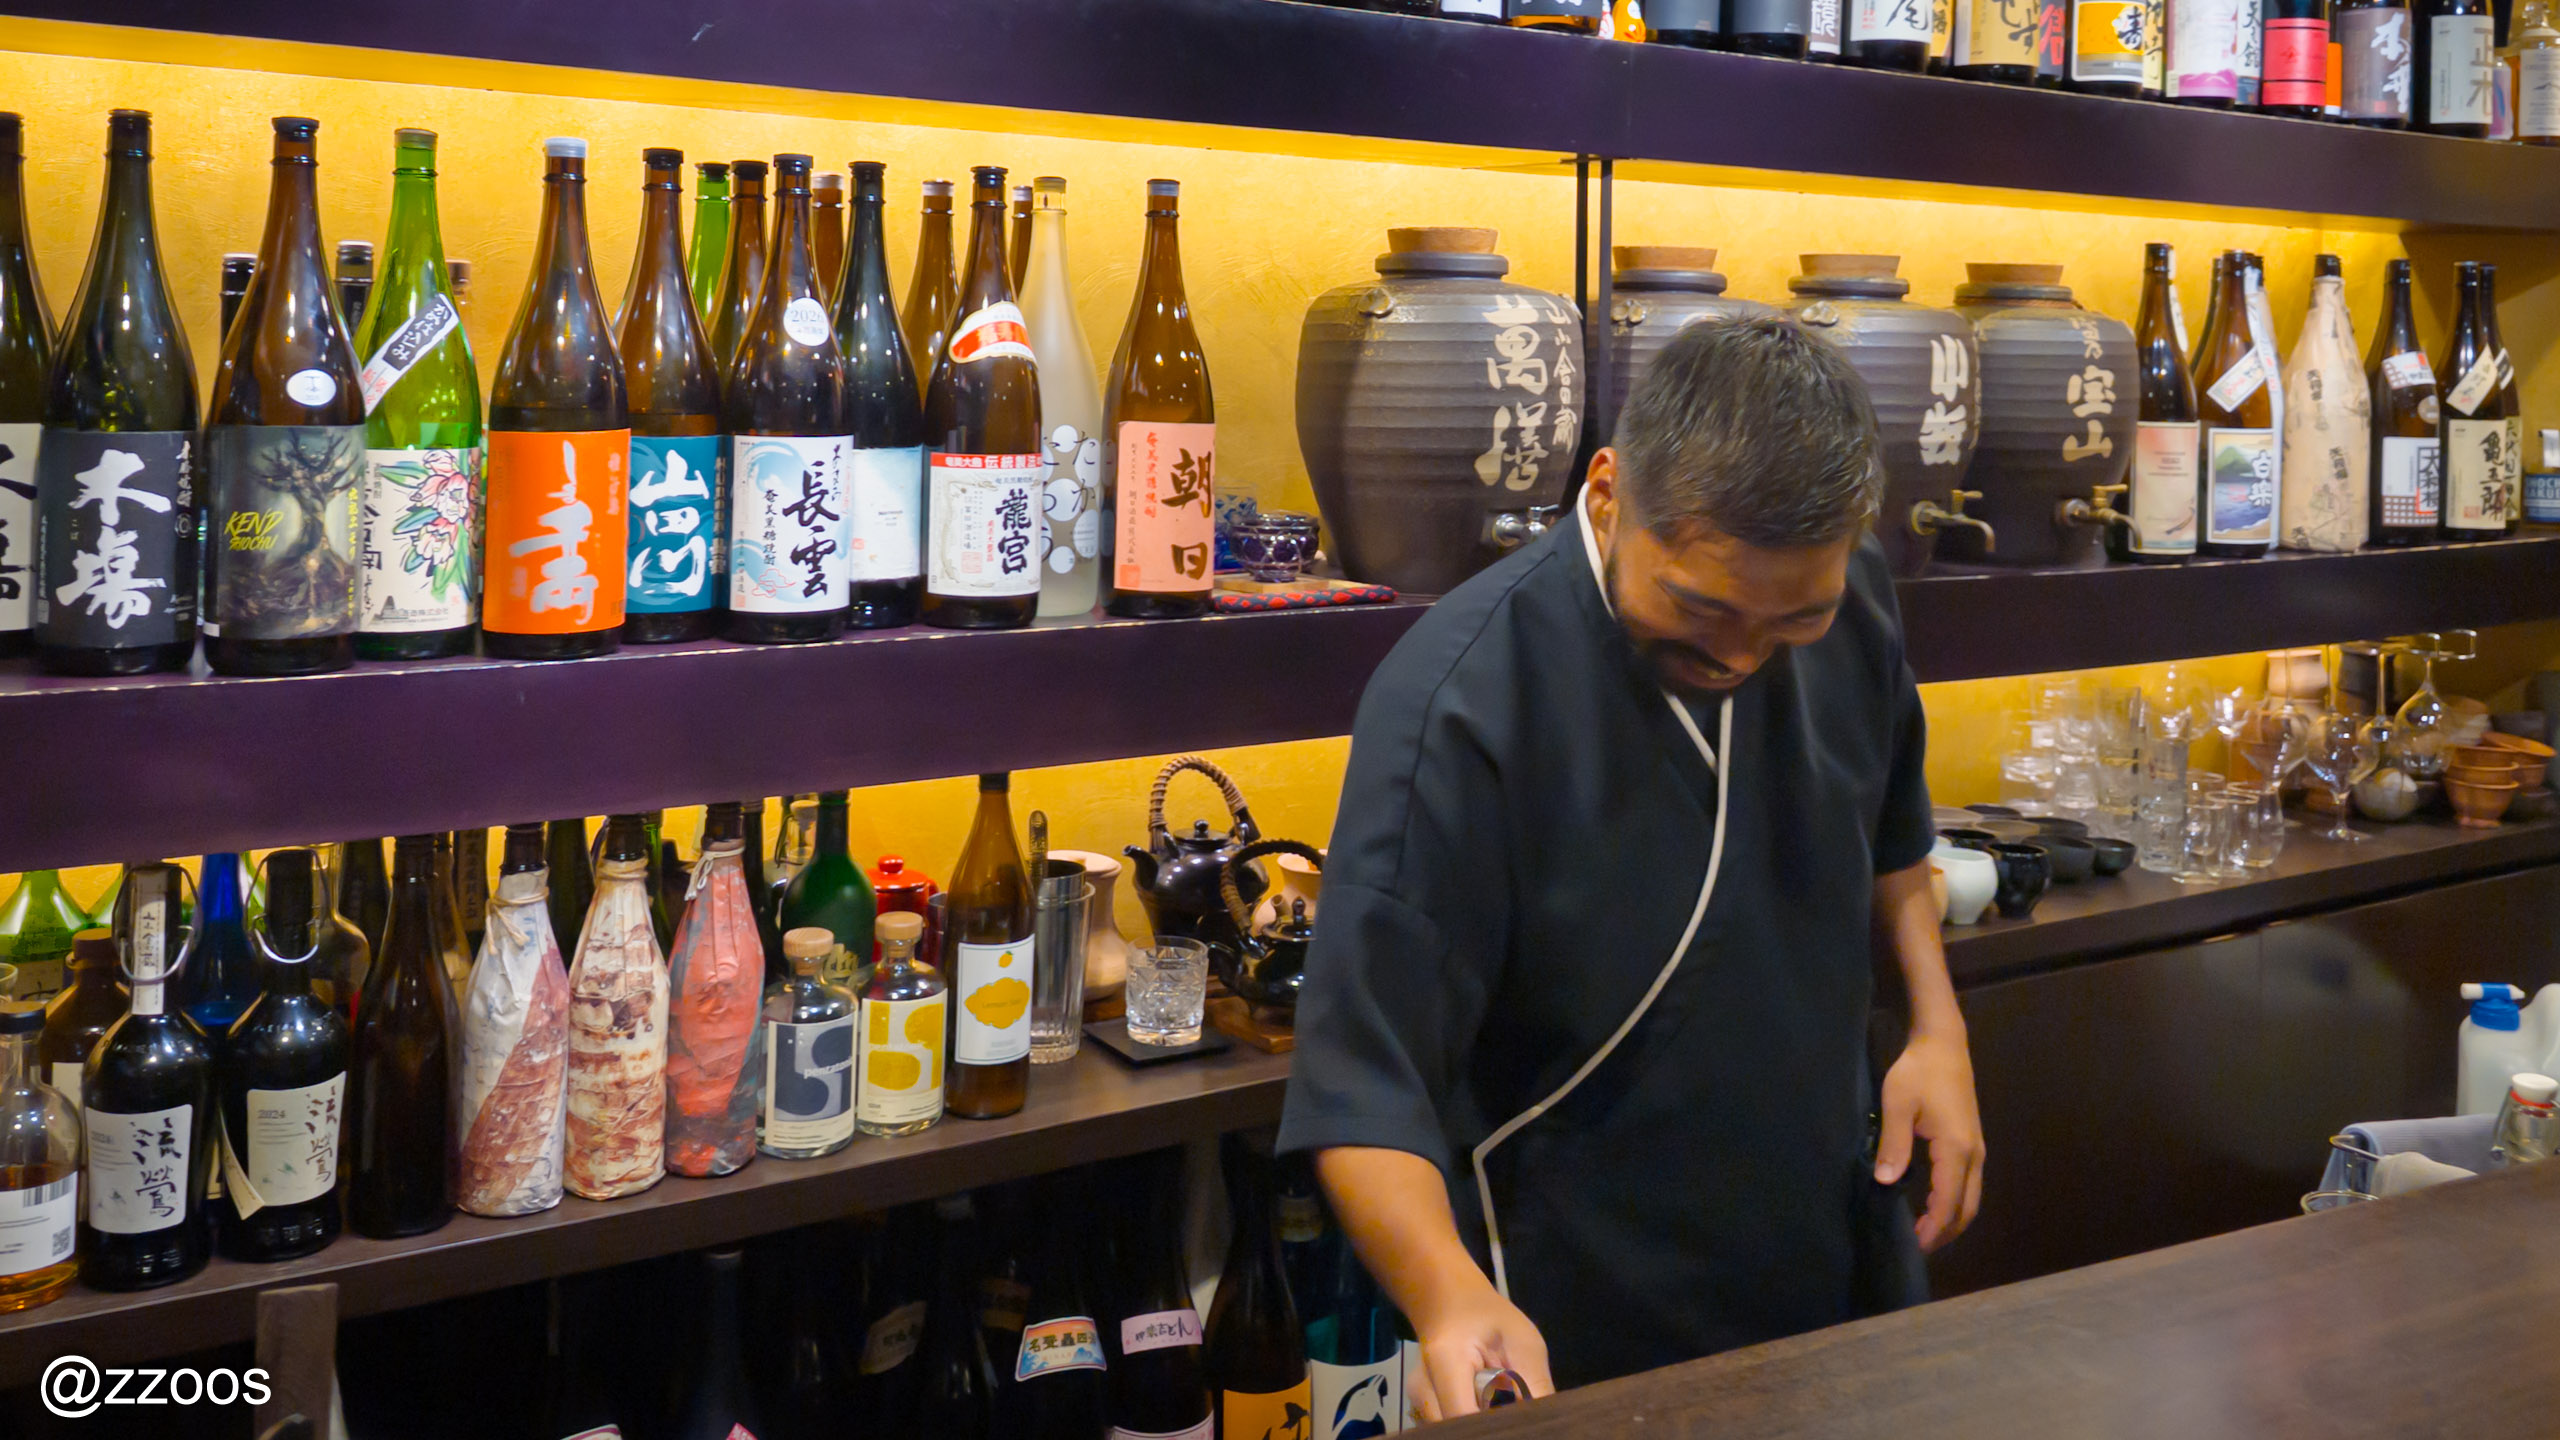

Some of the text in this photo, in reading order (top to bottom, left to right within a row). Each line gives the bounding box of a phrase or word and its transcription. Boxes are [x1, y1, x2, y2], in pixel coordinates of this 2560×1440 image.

[782, 460, 841, 599] 長雲
[995, 488, 1033, 575] 龍宮
[1160, 448, 1212, 581] 朝日
